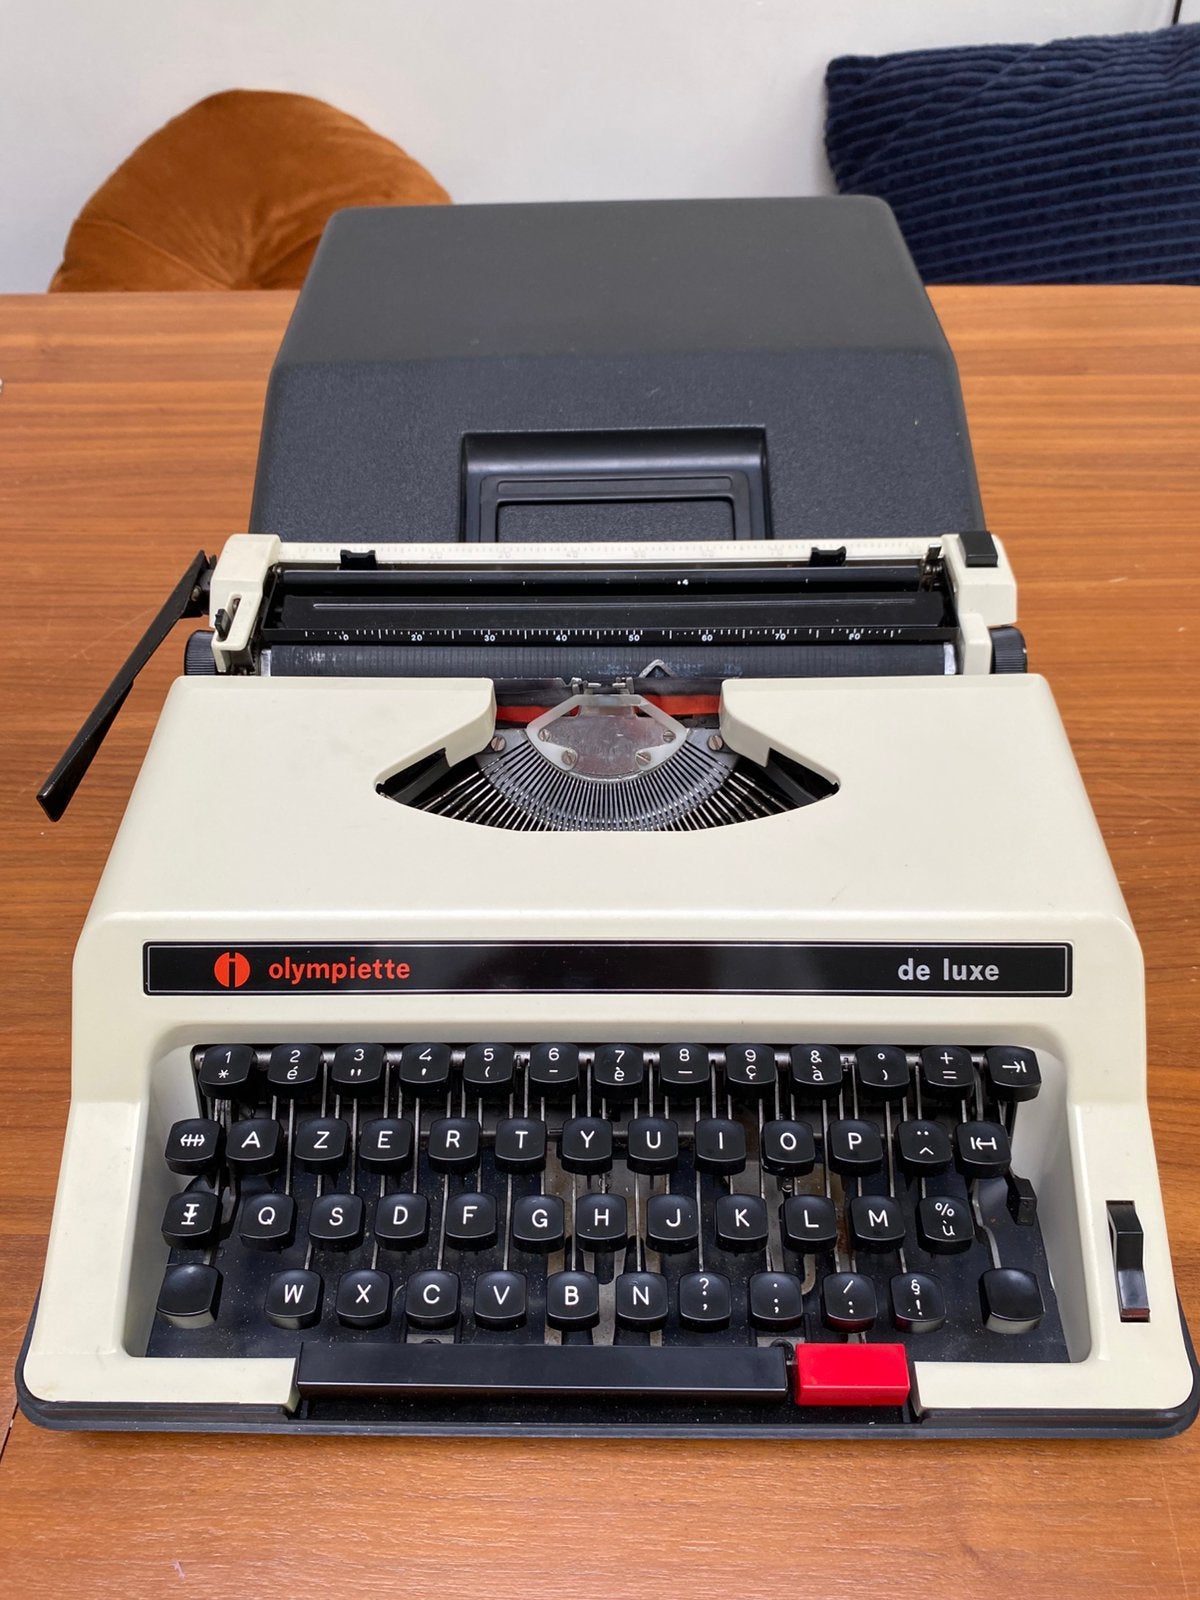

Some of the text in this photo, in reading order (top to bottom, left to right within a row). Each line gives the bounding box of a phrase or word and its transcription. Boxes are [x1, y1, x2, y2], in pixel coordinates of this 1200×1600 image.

[410, 633, 423, 642] 20
[483, 633, 496, 642] 30
[555, 633, 568, 642] 40
[627, 633, 641, 642] 50
[701, 633, 714, 642] 60
[774, 633, 787, 641] 70
[269, 956, 410, 985] olympiette
[898, 958, 999, 980] de luxe
[224, 1050, 232, 1064] 1
[289, 1049, 301, 1063] 2
[353, 1048, 365, 1062] 3
[418, 1048, 432, 1062] 4
[483, 1047, 494, 1062] 5
[548, 1047, 560, 1061] 6
[614, 1049, 625, 1063] 7
[679, 1048, 690, 1062] 8
[744, 1049, 757, 1063] 9
[810, 1049, 823, 1064] &
[940, 1051, 954, 1066] +
[286, 1065, 299, 1080] é
[483, 1066, 491, 1078] (
[613, 1066, 625, 1082] è
[745, 1065, 756, 1080] ç
[811, 1065, 824, 1081] à
[882, 1068, 889, 1081] )
[942, 1070, 957, 1080] =
[241, 1130, 261, 1149] A
[313, 1130, 330, 1149] Z
[377, 1130, 393, 1149] E
[445, 1129, 460, 1148] R
[515, 1130, 529, 1149] T
[580, 1130, 595, 1149] Y
[646, 1130, 661, 1149] U
[779, 1132, 797, 1151] O
[847, 1132, 862, 1150] P
[258, 1206, 276, 1226] Q
[329, 1207, 344, 1226] S
[393, 1205, 409, 1225] D
[462, 1205, 478, 1225] F
[531, 1208, 548, 1228] G
[594, 1208, 609, 1226] H
[665, 1208, 681, 1228] J
[735, 1208, 750, 1227] K
[868, 1209, 889, 1227] M
[934, 1202, 955, 1217] %
[803, 1209, 820, 1229] L
[941, 1219, 956, 1237] ù
[284, 1284, 304, 1304] W
[355, 1284, 372, 1304] X
[423, 1283, 441, 1304] C
[493, 1285, 510, 1305] V
[564, 1285, 580, 1306] B
[632, 1285, 650, 1306] N
[699, 1277, 710, 1296] ?
[843, 1279, 854, 1294] /
[910, 1278, 921, 1296] §
[915, 1299, 923, 1316] !
